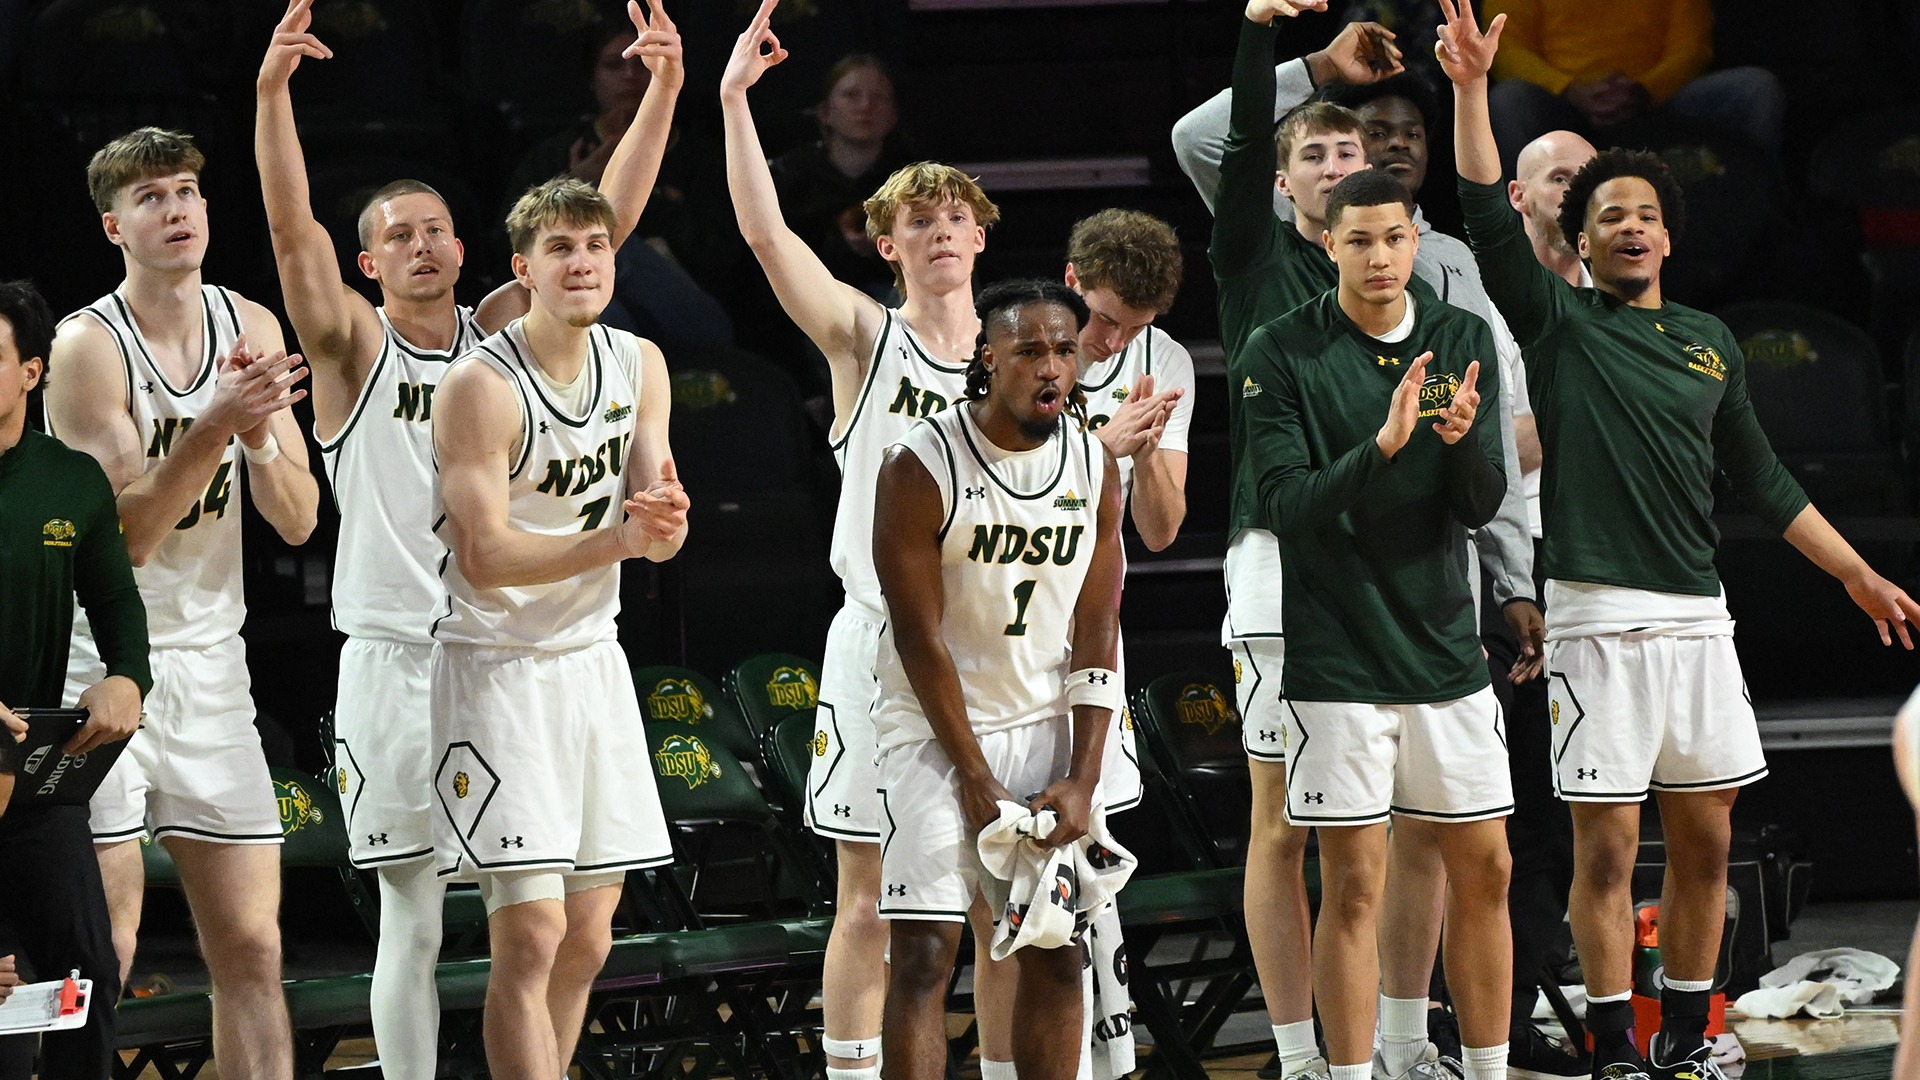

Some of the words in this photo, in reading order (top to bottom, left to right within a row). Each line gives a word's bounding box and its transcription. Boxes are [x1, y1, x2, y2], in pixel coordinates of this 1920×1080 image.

[888, 376, 967, 418] ND
[1419, 383, 1448, 400] DSU
[536, 431, 630, 497] NDSU
[1053, 498, 1087, 508] SUMMIT
[967, 524, 1085, 566] NDSU
[1003, 579, 1038, 636] 1
[649, 694, 690, 719] NDSU
[767, 683, 805, 706] NDSU
[36, 753, 71, 796] LDING
[655, 752, 697, 777] NDSU
